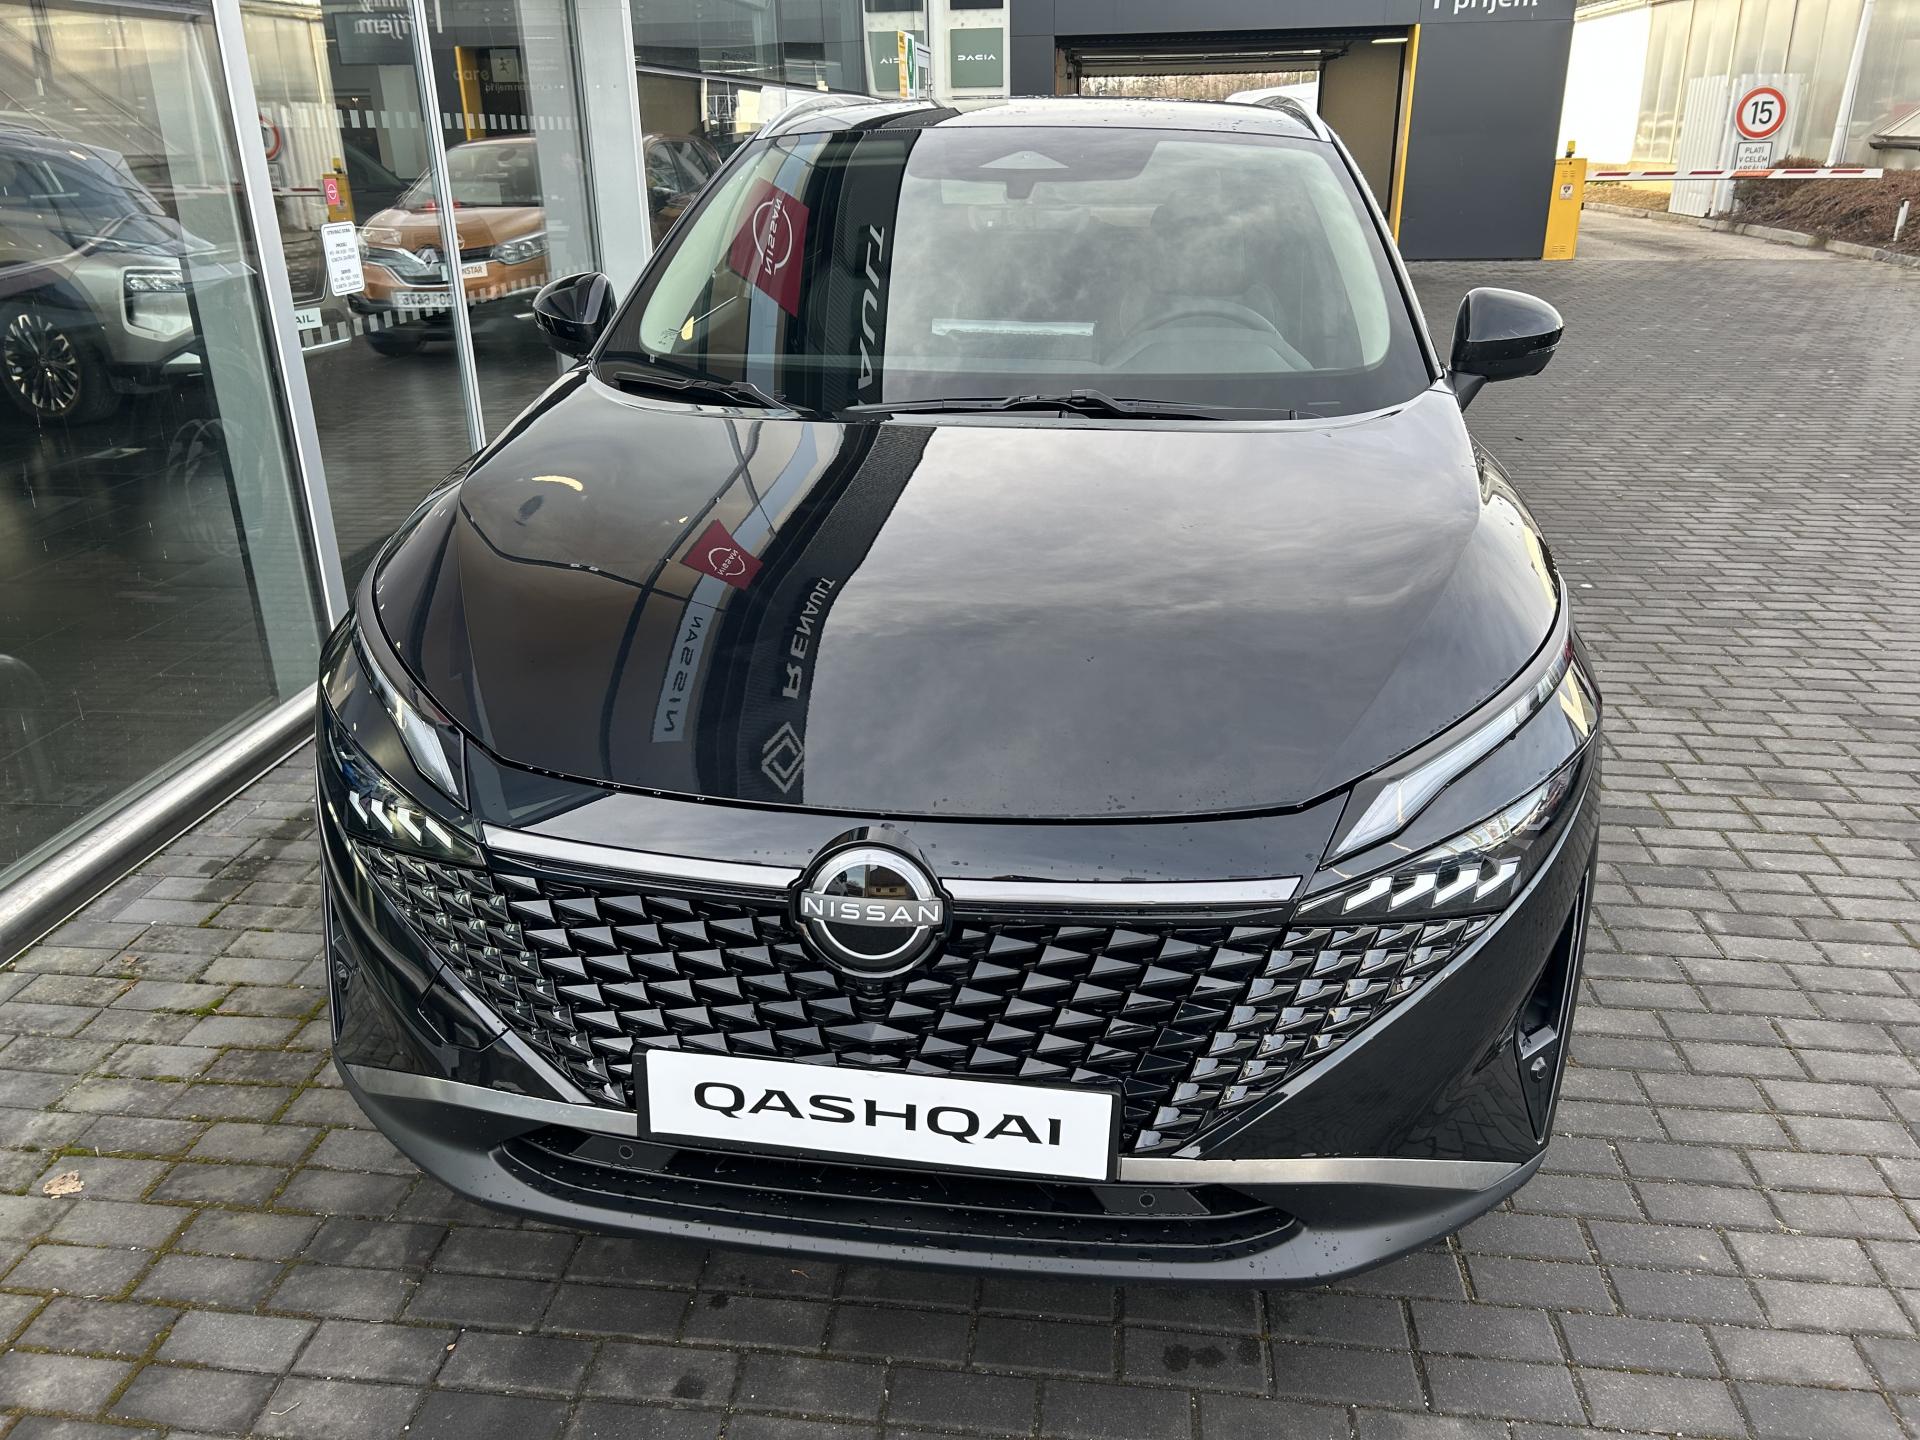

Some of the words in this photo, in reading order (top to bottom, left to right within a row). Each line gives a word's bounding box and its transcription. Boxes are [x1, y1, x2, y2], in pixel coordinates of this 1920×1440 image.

[1751, 100, 1775, 125] 15
[1745, 146, 1765, 154] PLATÍ
[803, 896, 941, 923] NISSAN
[693, 1081, 1062, 1146] QASHQAI
